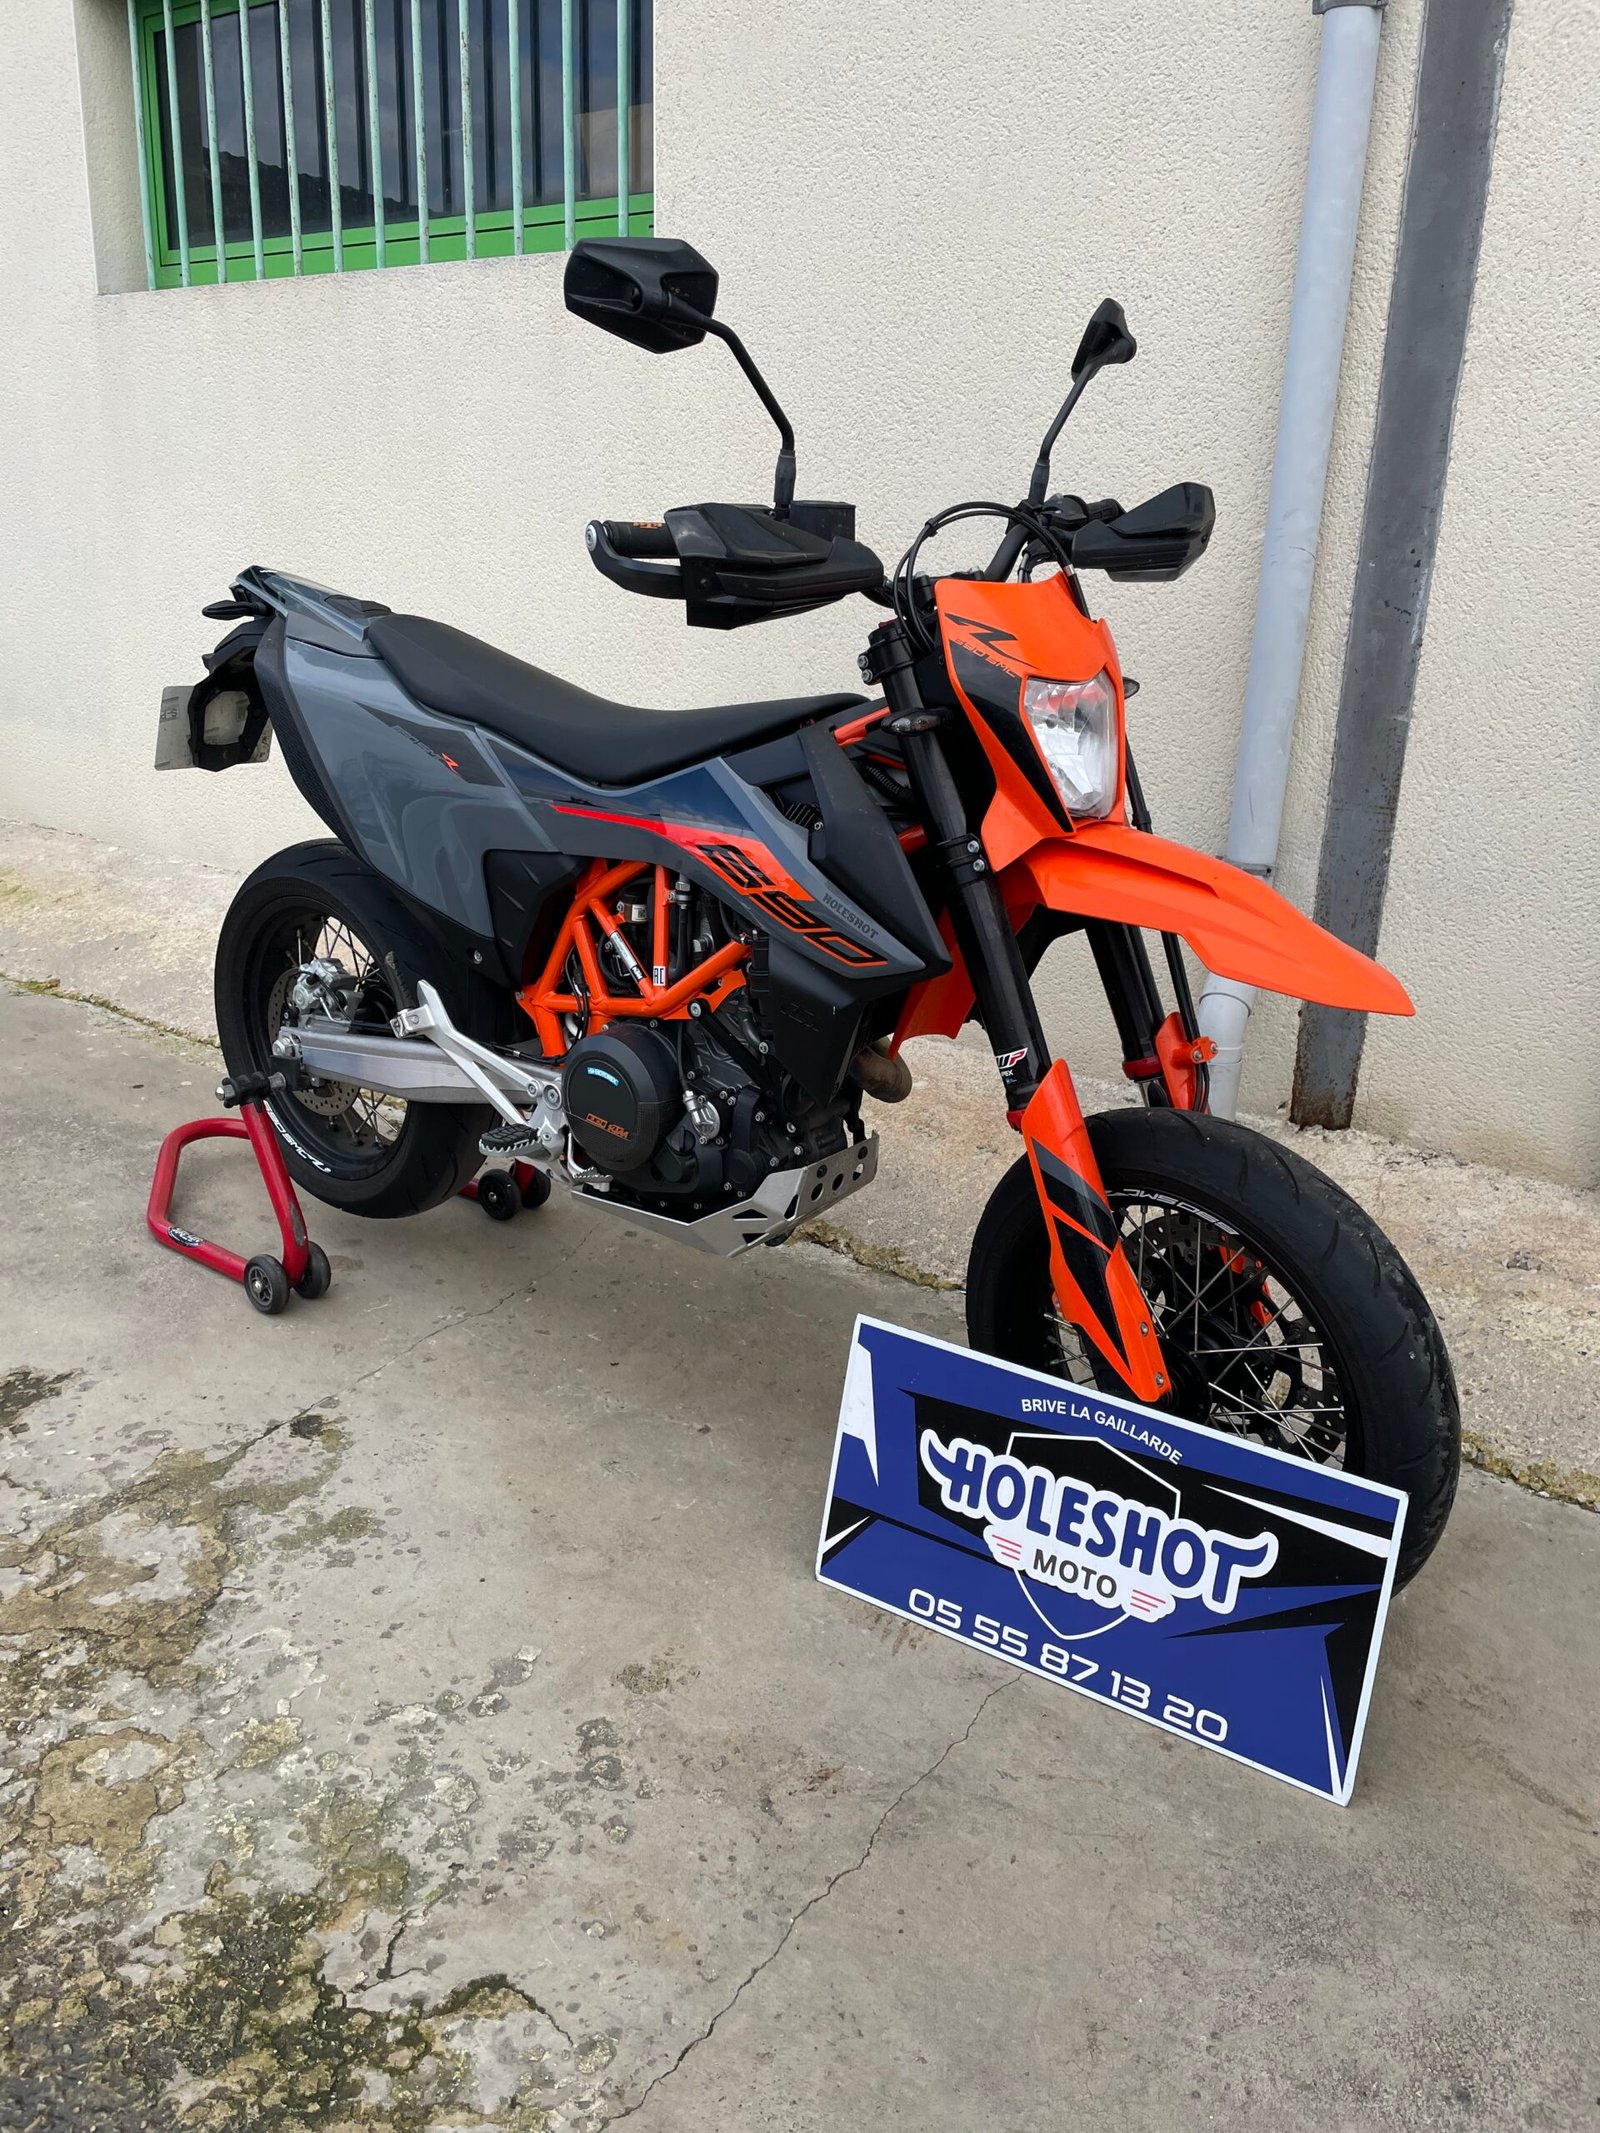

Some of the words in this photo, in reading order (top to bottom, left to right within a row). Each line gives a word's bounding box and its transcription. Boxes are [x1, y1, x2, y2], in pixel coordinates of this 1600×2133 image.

[695, 844, 888, 968] 690
[822, 893, 880, 939] HOLESHOT
[1020, 1399, 1067, 1415] BRIVE
[1070, 1403, 1091, 1421] LA
[1094, 1411, 1183, 1466] GAILLARDE
[926, 1431, 1271, 1606] HOLESHOT
[1033, 1548, 1117, 1599] MOTO
[908, 1588, 963, 1630] 05
[972, 1613, 1029, 1658] 55
[1039, 1642, 1100, 1682] 87
[1110, 1669, 1151, 1710] 13
[1162, 1693, 1228, 1742] 20
